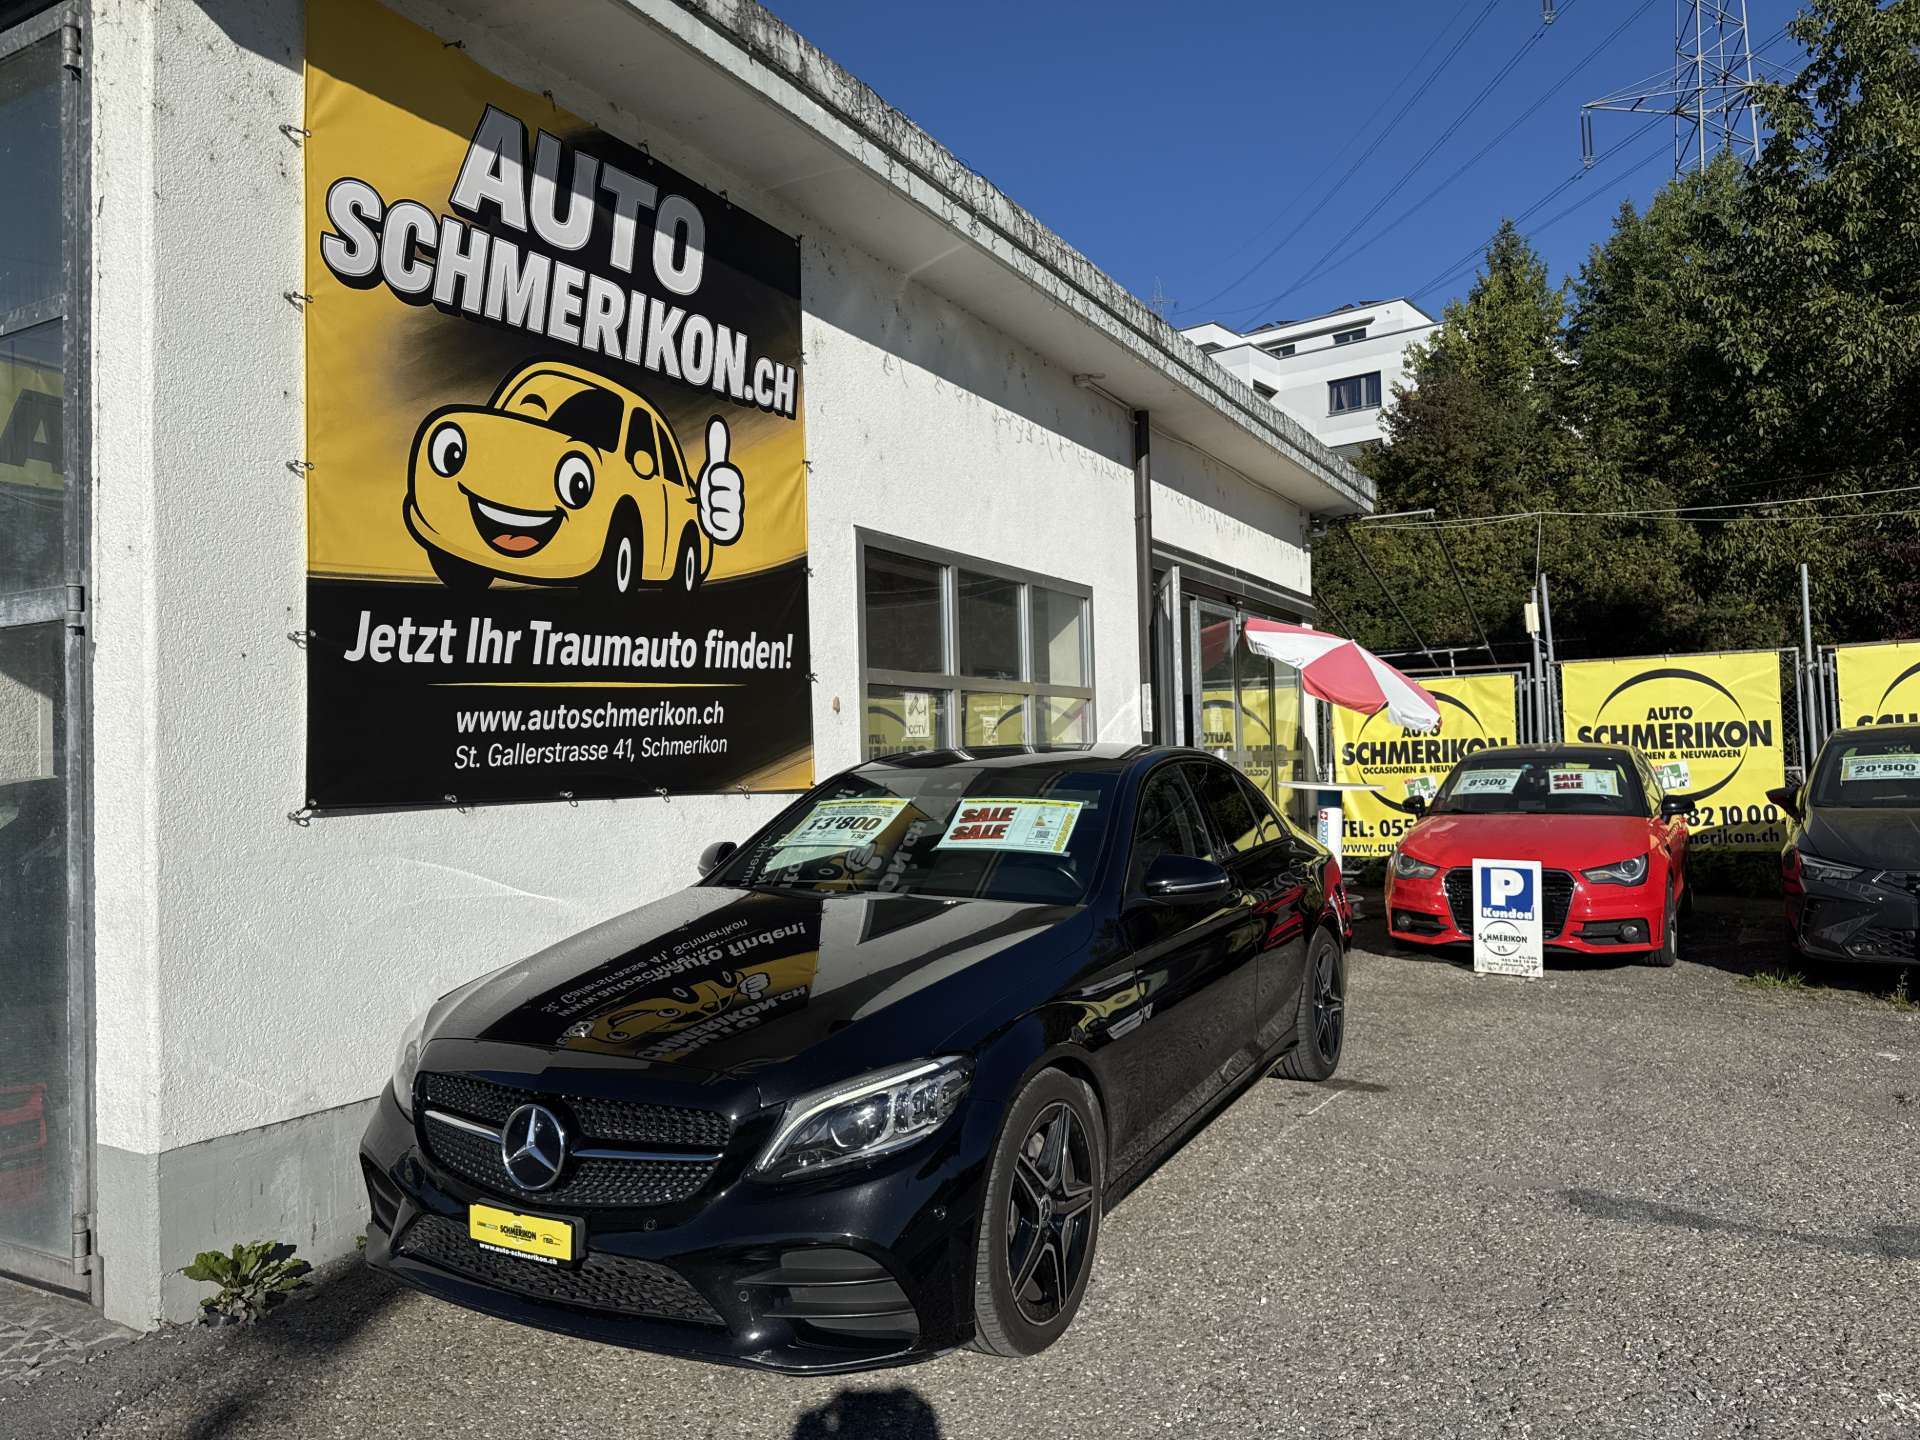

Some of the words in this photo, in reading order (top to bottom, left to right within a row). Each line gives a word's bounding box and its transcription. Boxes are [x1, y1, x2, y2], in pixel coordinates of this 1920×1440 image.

[450, 105, 706, 296] AUTO
[322, 179, 797, 415] SCHMERIKON.CH
[344, 610, 457, 664] Jetzt
[465, 617, 521, 665] Ihr
[529, 620, 697, 668] Traumauto
[704, 628, 794, 669] finden!
[456, 701, 724, 733] www.autoschmerikon.ch
[1646, 706, 1693, 721] AUTO
[1577, 719, 1772, 750] SCHMERIKON
[453, 745, 481, 769] St.
[487, 742, 608, 767] Gallerstrasse
[612, 739, 636, 762] 41,
[641, 735, 728, 758] Schmerikon
[1669, 751, 1677, 759] &
[1681, 749, 1741, 759] NEUWAGEN
[1362, 766, 1417, 775] OCCASIONEN
[1420, 765, 1427, 773] &
[1855, 764, 1916, 774] 20'800
[1468, 778, 1507, 787] 8'300
[1553, 773, 1584, 782] SALE
[1553, 782, 1584, 790] SALE
[959, 807, 1017, 823] SALE
[808, 816, 882, 831] 13'800
[1342, 820, 1375, 837] TEL:
[950, 824, 1010, 840] SALE
[1490, 869, 1524, 906] P
[1478, 933, 1528, 944] SHMERIKON
